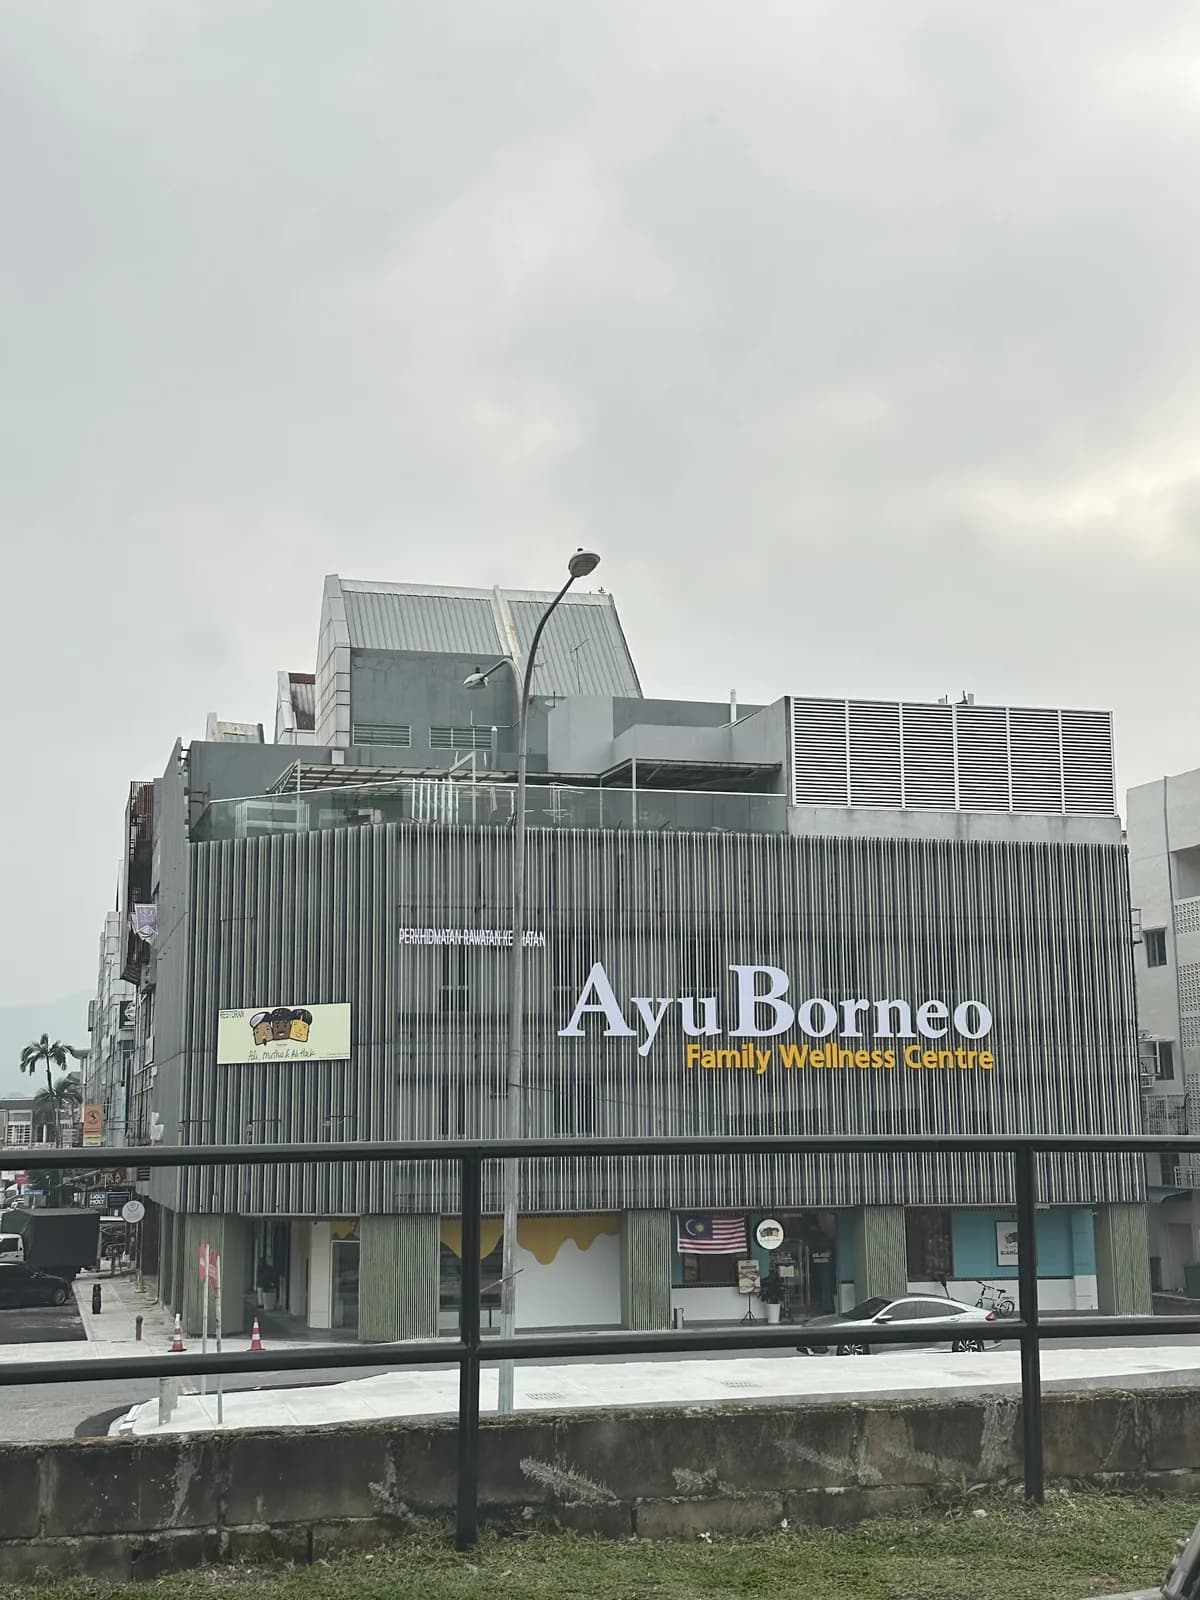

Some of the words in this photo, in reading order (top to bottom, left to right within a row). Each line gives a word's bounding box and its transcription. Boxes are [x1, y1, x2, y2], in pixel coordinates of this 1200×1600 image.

[399, 928, 461, 944] PERKHIDMATAN
[463, 929, 501, 946] RAWATAN
[685, 1042, 772, 1075] Family
[779, 1042, 896, 1070] Wellness
[904, 1044, 995, 1070] Centre
